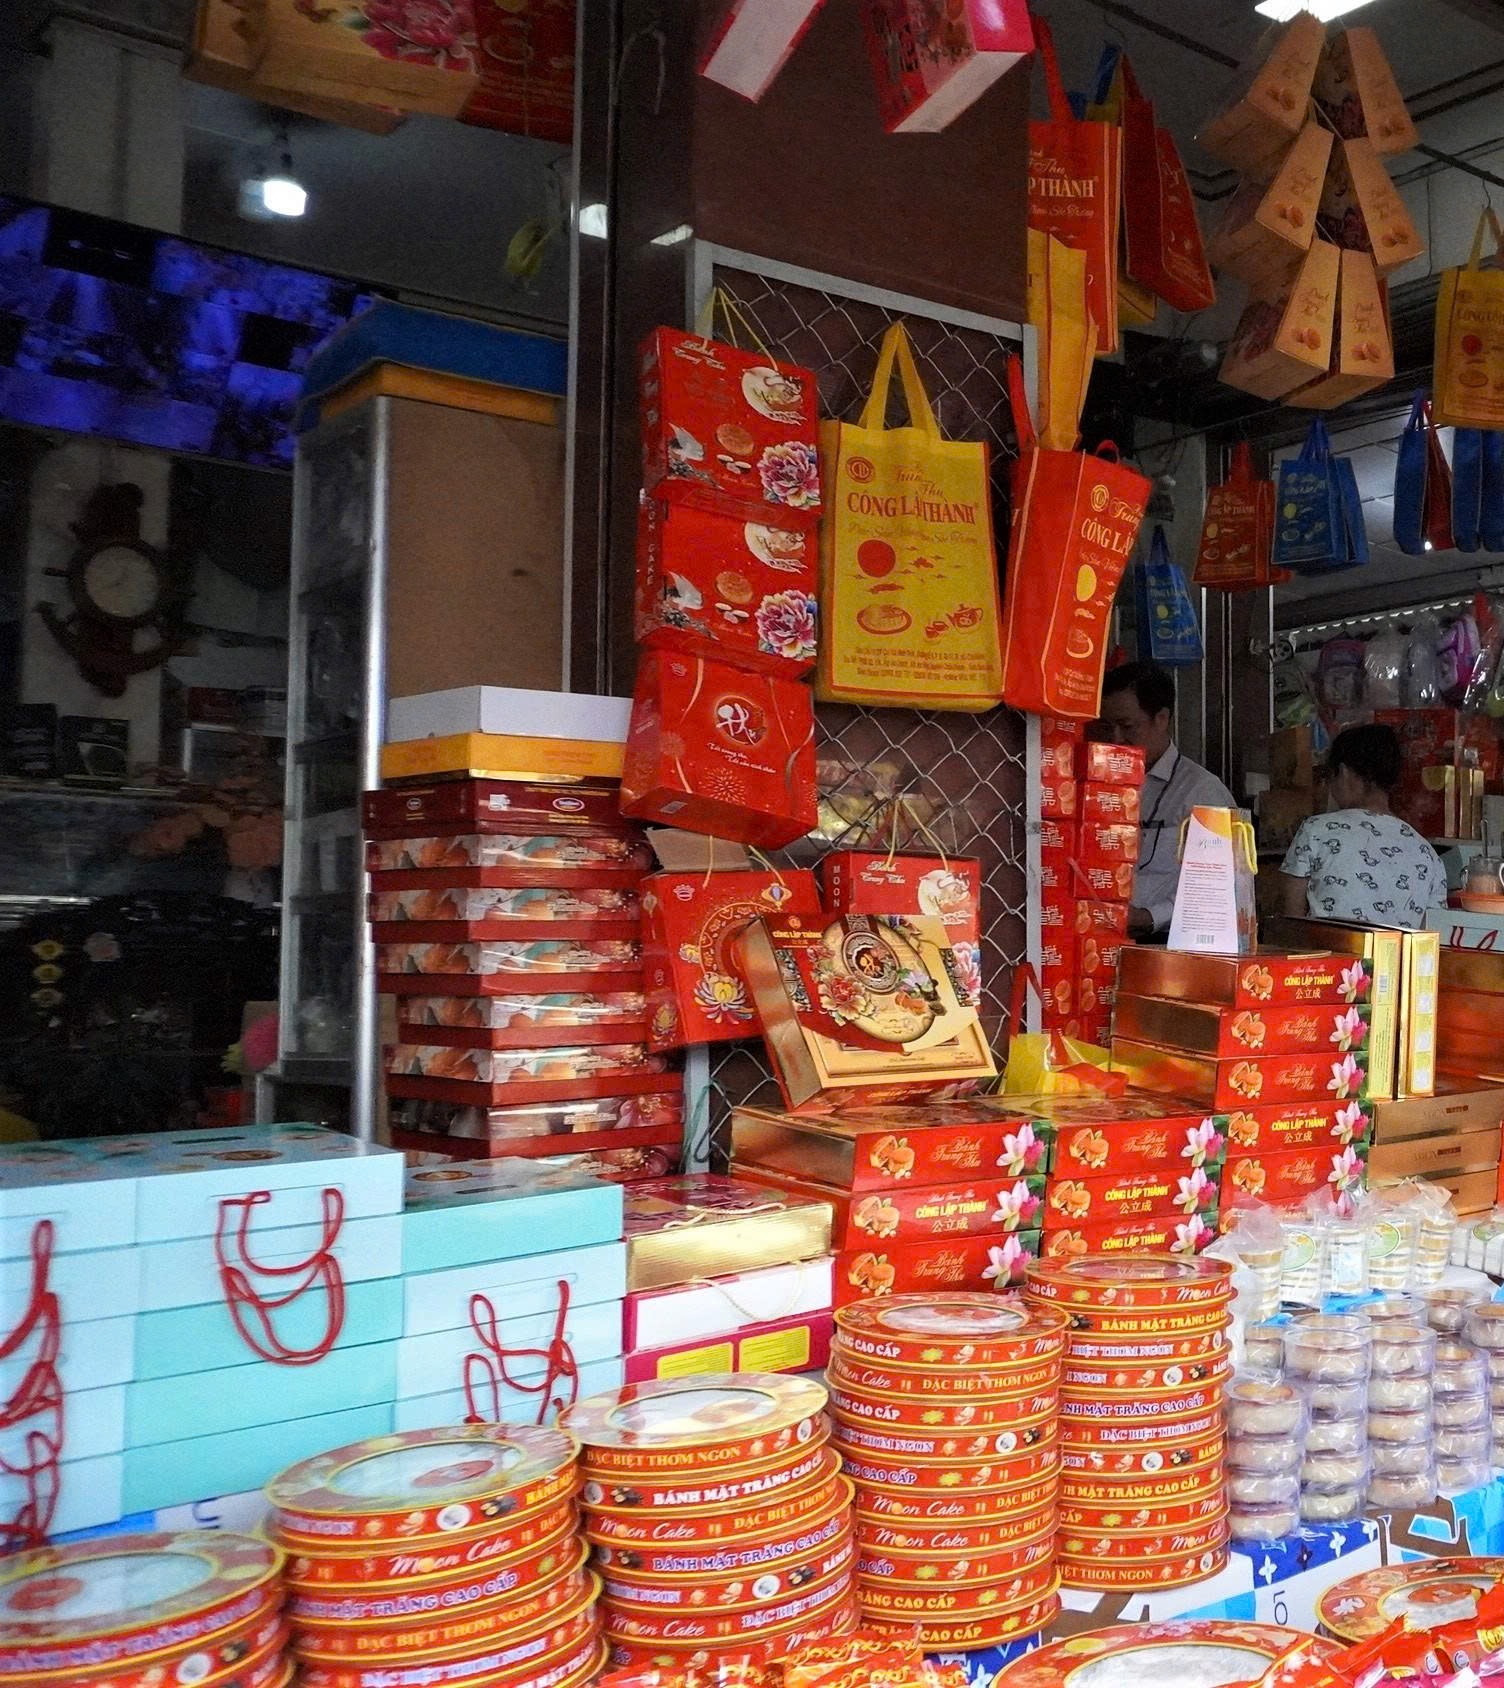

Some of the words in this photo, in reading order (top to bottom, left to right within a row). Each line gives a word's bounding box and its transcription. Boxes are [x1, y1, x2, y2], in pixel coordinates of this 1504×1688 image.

[1039, 173, 1094, 198] THÀNH
[847, 490, 897, 517] CÔNG
[1081, 515, 1110, 546] CÔNG
[832, 865, 841, 907] MOON
[1284, 975, 1301, 986] CÔNG
[1301, 975, 1313, 987] LẬP
[1313, 974, 1333, 984] THÀNH
[1295, 988, 1321, 999] 公立成
[1271, 1120, 1292, 1132] CÔNG
[1292, 1120, 1305, 1130] LẬP
[1305, 1117, 1326, 1127] THÀNH
[1284, 1131, 1313, 1144] 公立成
[1105, 1188, 1126, 1201] CÔNG
[1127, 1188, 1142, 1200] LẬP
[1143, 1184, 1168, 1197] THÀNH
[916, 1202, 939, 1219] CÔNG
[940, 1203, 958, 1217] LẬP
[958, 1199, 987, 1214] THÀNH
[1119, 1201, 1152, 1215] 公立成
[931, 1218, 969, 1233] 公立成
[1102, 1236, 1124, 1250] CÔNG
[1124, 1236, 1140, 1249] LẬP
[1140, 1232, 1166, 1245] THÀNH
[1040, 1283, 1057, 1298] CẤP
[1101, 1318, 1138, 1331] BÁNH
[1140, 1319, 1167, 1332] MẶT
[1169, 1313, 1205, 1329] TRĂNG
[855, 1339, 875, 1354] CAO
[875, 1341, 901, 1358] CẤP
[862, 1371, 892, 1389] Cake
[923, 1379, 950, 1392] ĐẶC
[954, 1375, 984, 1392] BIỆT
[986, 1375, 1022, 1389] THƠM
[1023, 1368, 1047, 1383] NGON
[852, 1401, 873, 1416] CAO
[875, 1404, 900, 1421] CẤP
[1084, 1403, 1113, 1417] MẶT
[1115, 1399, 1160, 1415] TRĂNG
[1160, 1398, 1185, 1412] CAO
[612, 1451, 645, 1468] BIỆT
[648, 1450, 694, 1467] THƠM
[698, 1446, 741, 1462] NGON
[889, 1468, 917, 1485] CẤP
[653, 1488, 701, 1505] BÁNH
[703, 1483, 739, 1503] MẶT
[741, 1470, 791, 1495] TRĂNG
[1078, 1485, 1106, 1500] MẶT
[1108, 1484, 1152, 1498] TRĂNG
[1155, 1480, 1179, 1494] CAO
[1181, 1473, 1200, 1489] CẤP
[872, 1495, 920, 1516] Moon
[926, 1501, 965, 1516] Cake
[996, 1493, 1019, 1508] ĐẶC
[600, 1516, 647, 1539] Moon
[653, 1522, 697, 1540] Cake
[734, 1513, 763, 1531] ĐẶC
[876, 1527, 925, 1547] Moon
[930, 1531, 969, 1548] Cake
[1000, 1525, 1021, 1539] ĐẶC
[388, 1554, 461, 1576] Moon
[466, 1538, 513, 1562] Cake
[653, 1554, 698, 1570] BÁNH
[700, 1547, 738, 1571] MẶT
[741, 1540, 794, 1563] TRĂNG
[796, 1531, 822, 1550] CAO
[1080, 1566, 1115, 1580] THƠM
[1119, 1570, 1153, 1581] NGON
[372, 1588, 437, 1617] TRĂNG
[441, 1585, 481, 1607] CAO
[483, 1570, 519, 1597] CẤP
[894, 1594, 924, 1609] CAO
[926, 1592, 957, 1609] CẤP
[612, 1614, 657, 1637] Moon
[663, 1620, 705, 1638] Cake
[920, 1627, 950, 1642] CAO
[950, 1623, 982, 1641] CẤP
